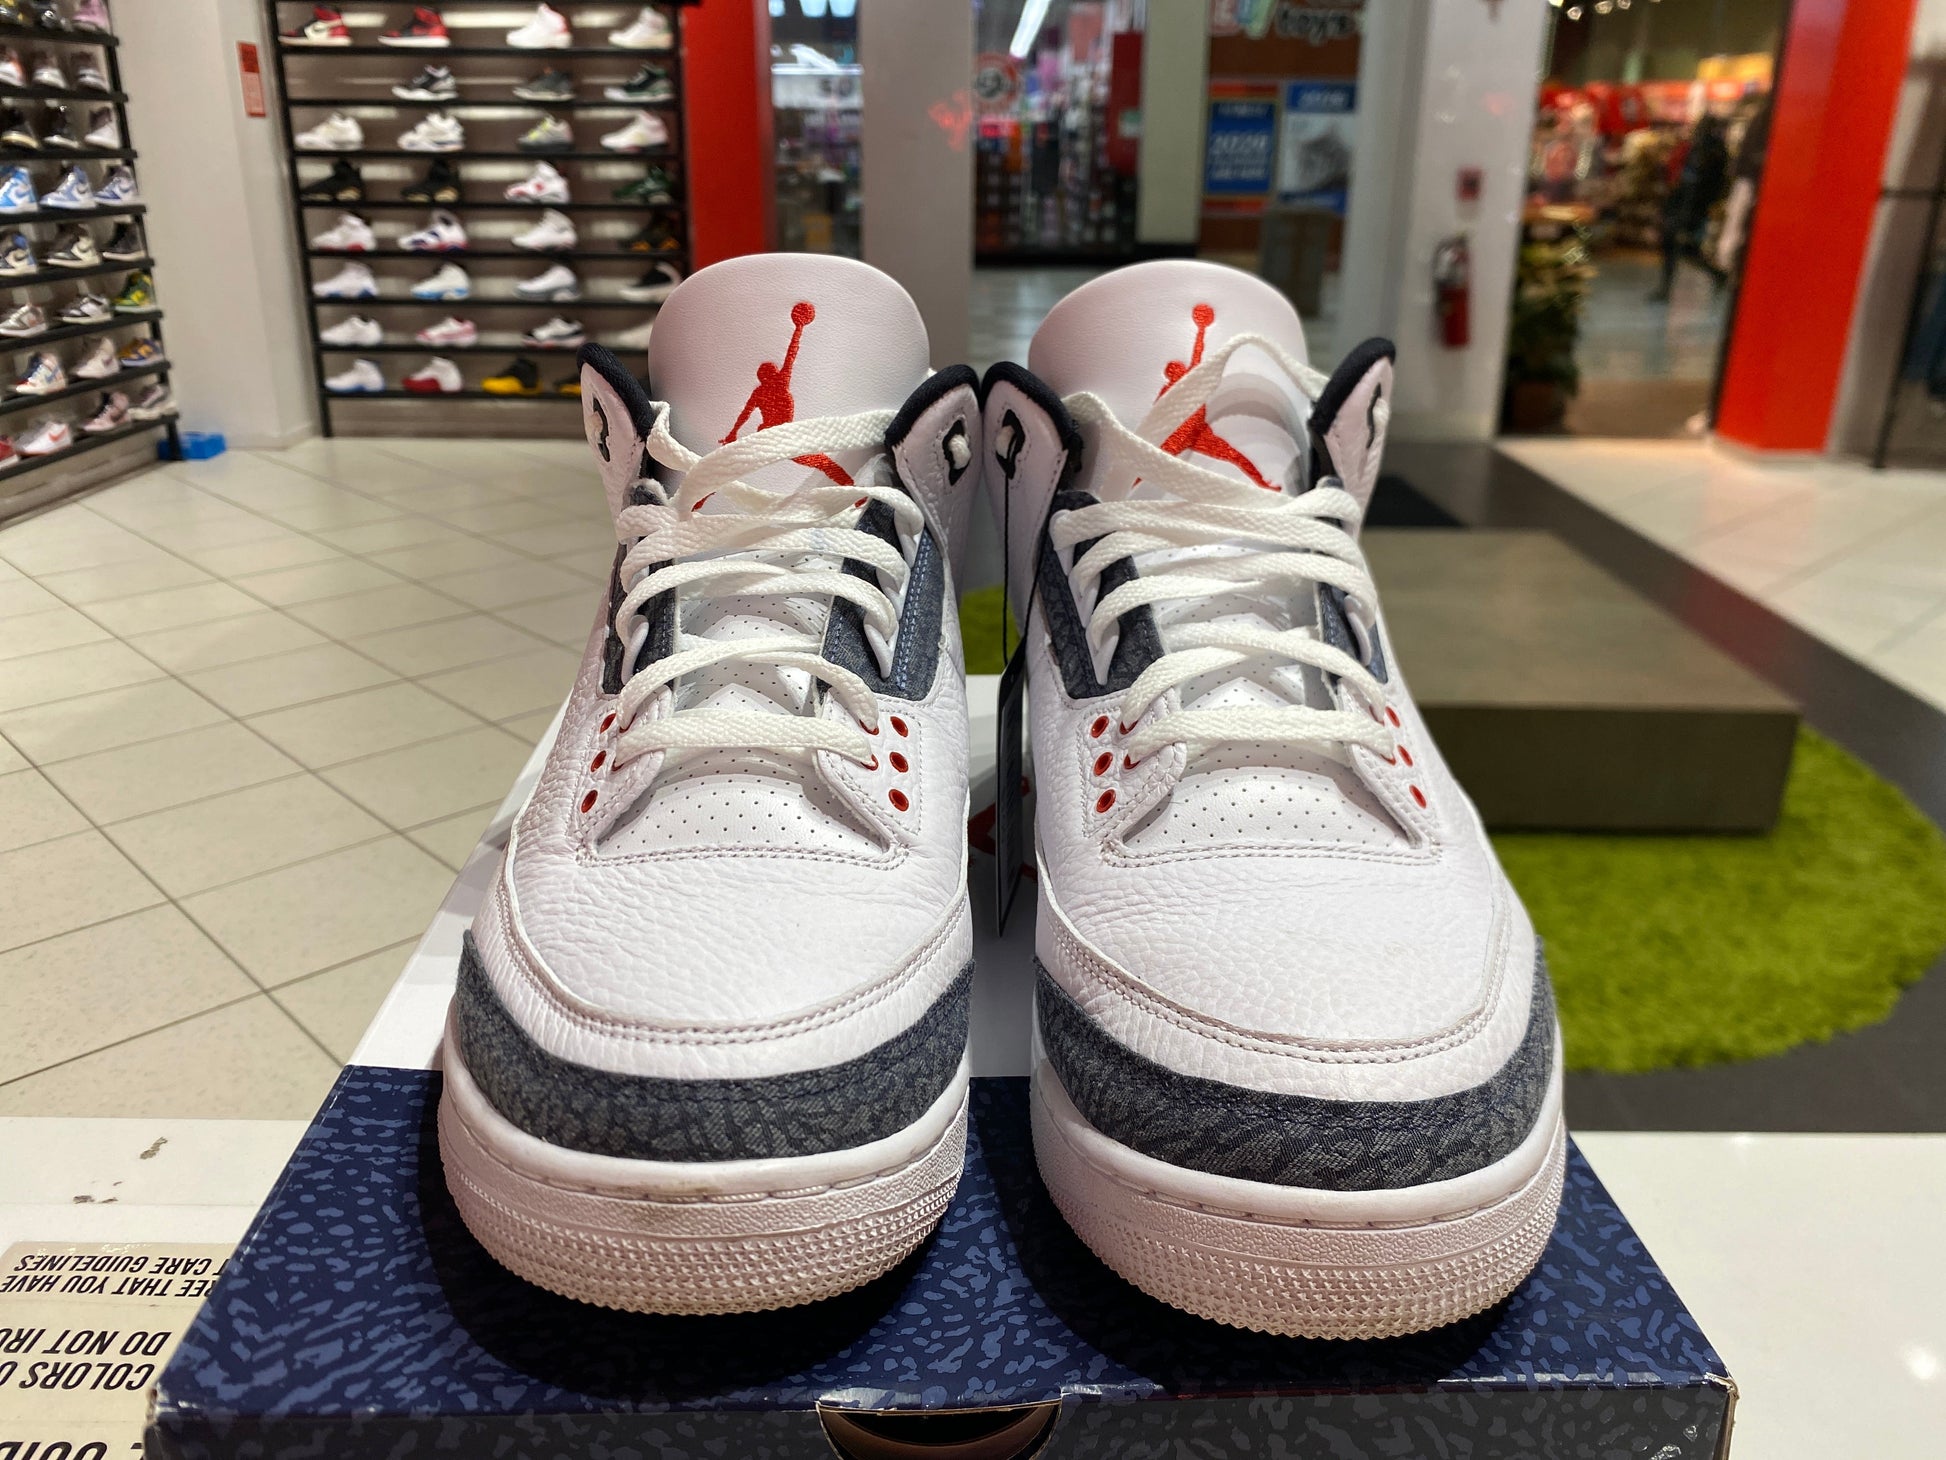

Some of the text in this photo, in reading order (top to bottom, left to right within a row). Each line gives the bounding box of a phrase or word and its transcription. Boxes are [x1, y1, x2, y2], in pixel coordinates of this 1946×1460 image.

[14, 1255, 149, 1272] GUIDELINES
[149, 1257, 213, 1275] CARE
[0, 1275, 62, 1292] HAVE
[60, 1275, 109, 1294] YOU
[111, 1277, 173, 1296] THAT
[43, 1330, 120, 1355] NOT
[119, 1331, 172, 1356] DO
[19, 1362, 155, 1390] COLORS
